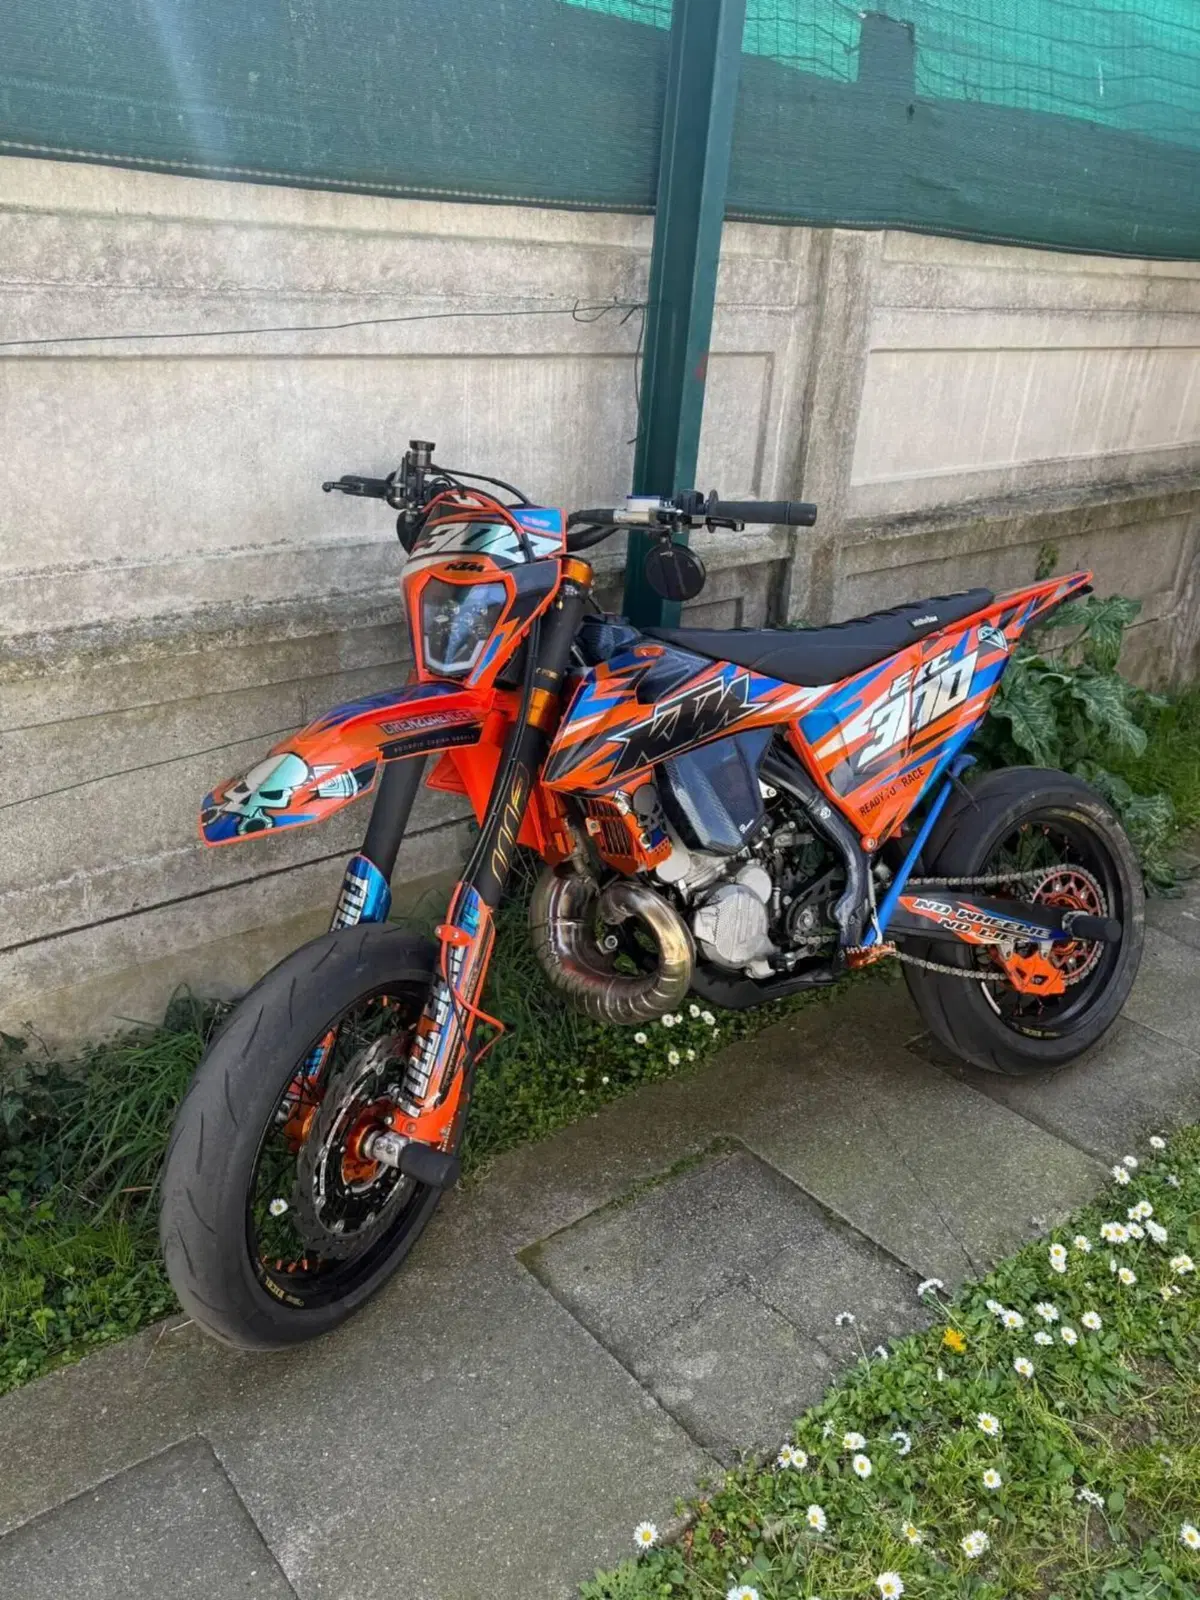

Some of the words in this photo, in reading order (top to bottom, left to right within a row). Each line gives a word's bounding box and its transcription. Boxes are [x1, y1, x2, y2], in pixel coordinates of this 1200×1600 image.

[444, 561, 485, 573] KTM
[607, 673, 770, 779] KTM
[858, 793, 886, 816] READY
[901, 767, 926, 787] RACE
[912, 898, 953, 915] NO
[956, 908, 1051, 939] WHEELIE
[938, 917, 973, 934] NO
